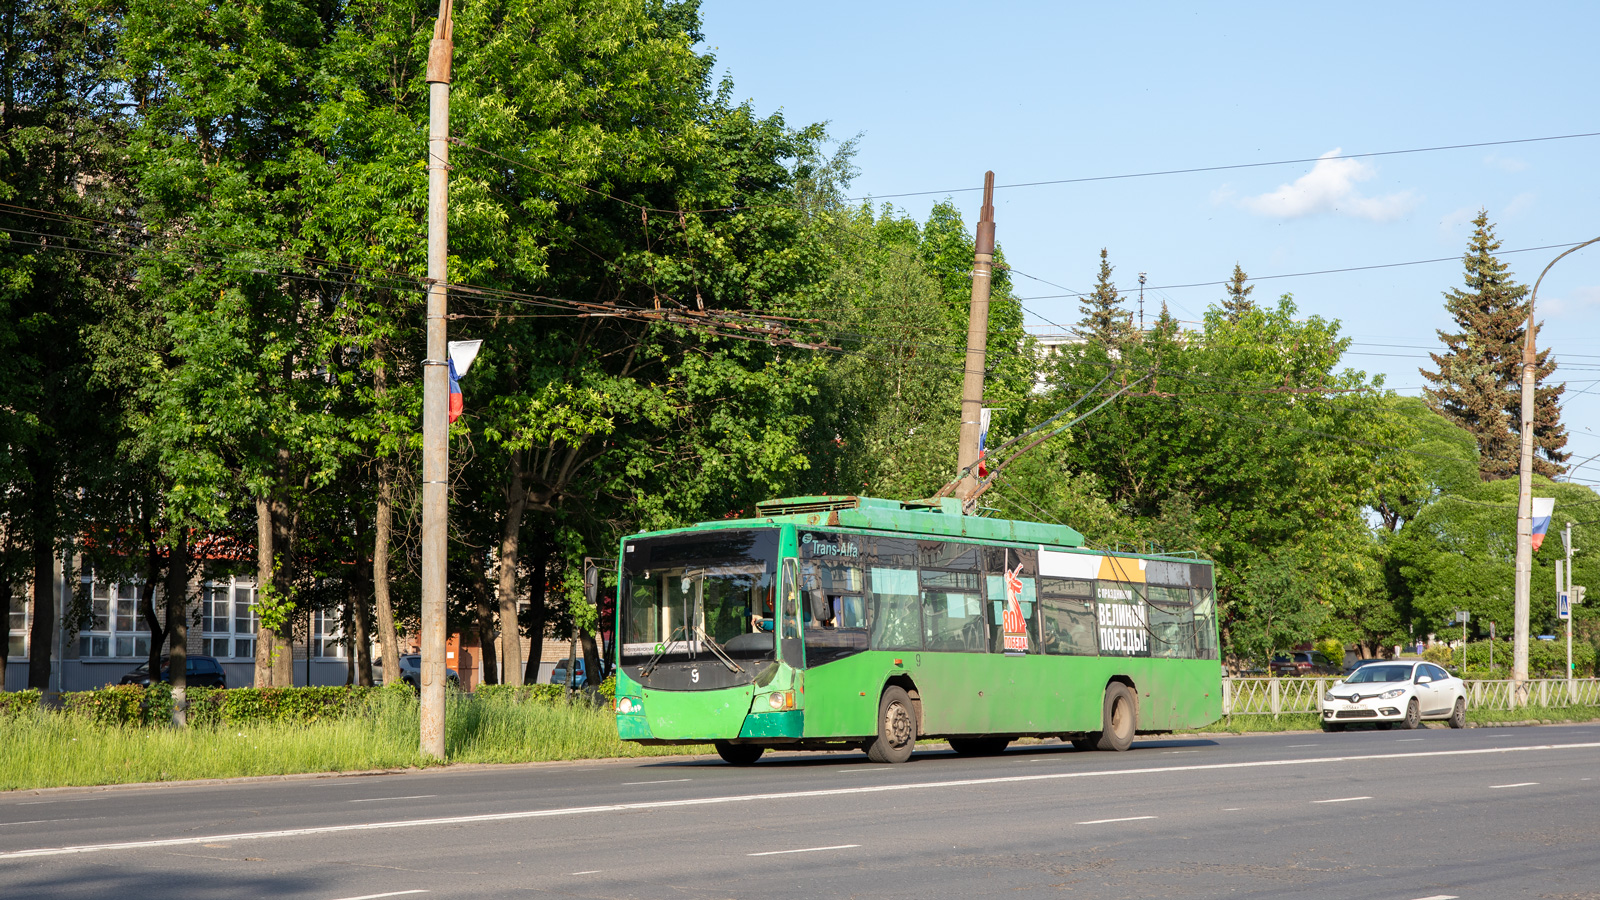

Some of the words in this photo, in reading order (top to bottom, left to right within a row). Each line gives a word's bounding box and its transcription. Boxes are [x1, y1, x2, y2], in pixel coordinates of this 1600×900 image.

[812, 539, 858, 558] Trans-Alfa
[1003, 610, 1016, 633] 80
[1098, 601, 1146, 628] ВЕЛИКОЙ
[1004, 636, 1028, 651] ПОБЕДА!
[1100, 627, 1148, 655] ПОБЕДЫ!
[916, 653, 921, 667] 9
[691, 668, 700, 683] 9
